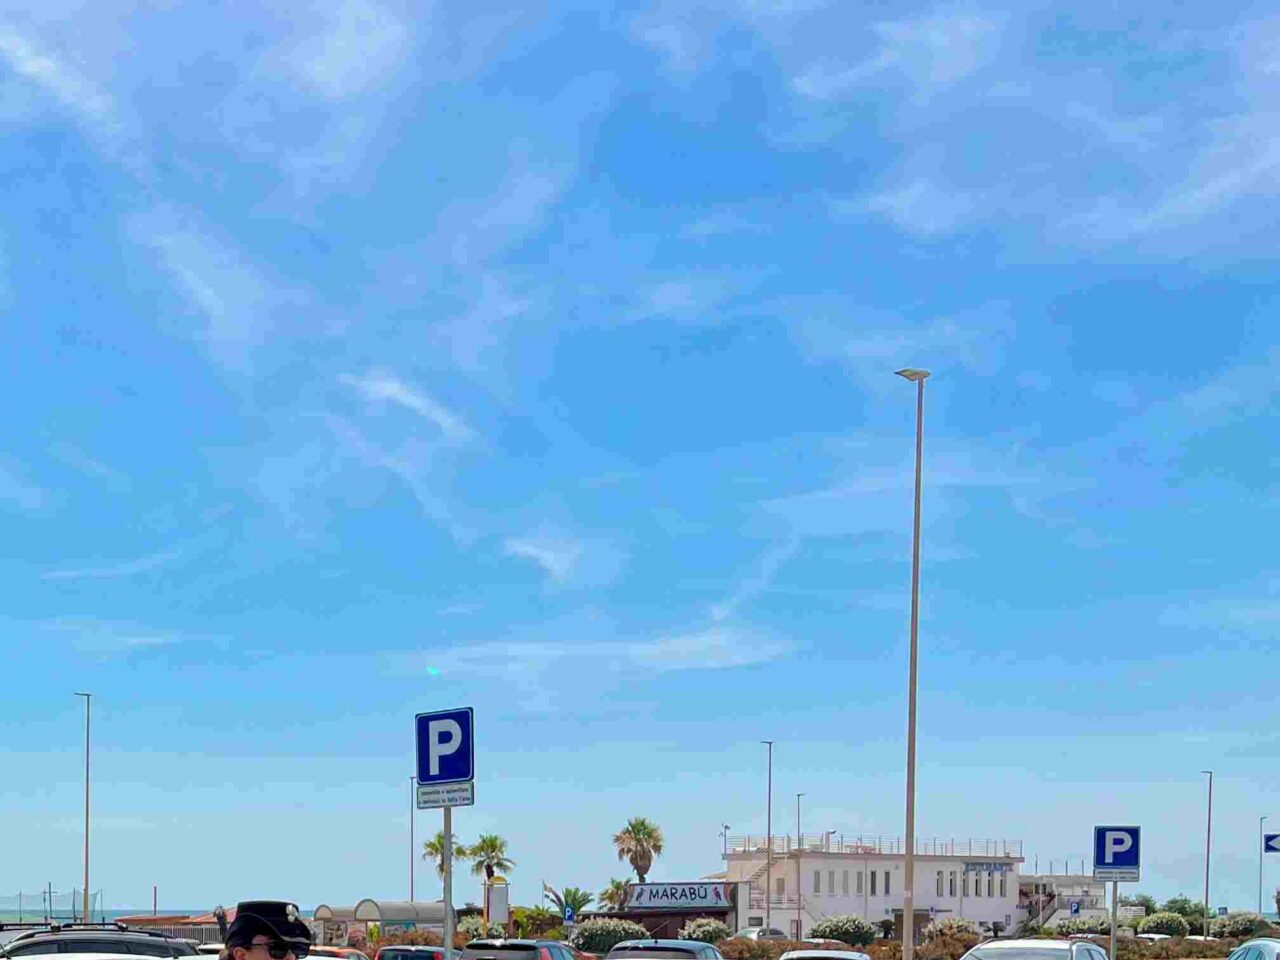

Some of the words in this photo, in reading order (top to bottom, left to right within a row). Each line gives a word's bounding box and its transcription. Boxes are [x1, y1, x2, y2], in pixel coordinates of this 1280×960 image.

[428, 718, 463, 776] P
[1104, 831, 1133, 864] P
[565, 907, 572, 920] P
